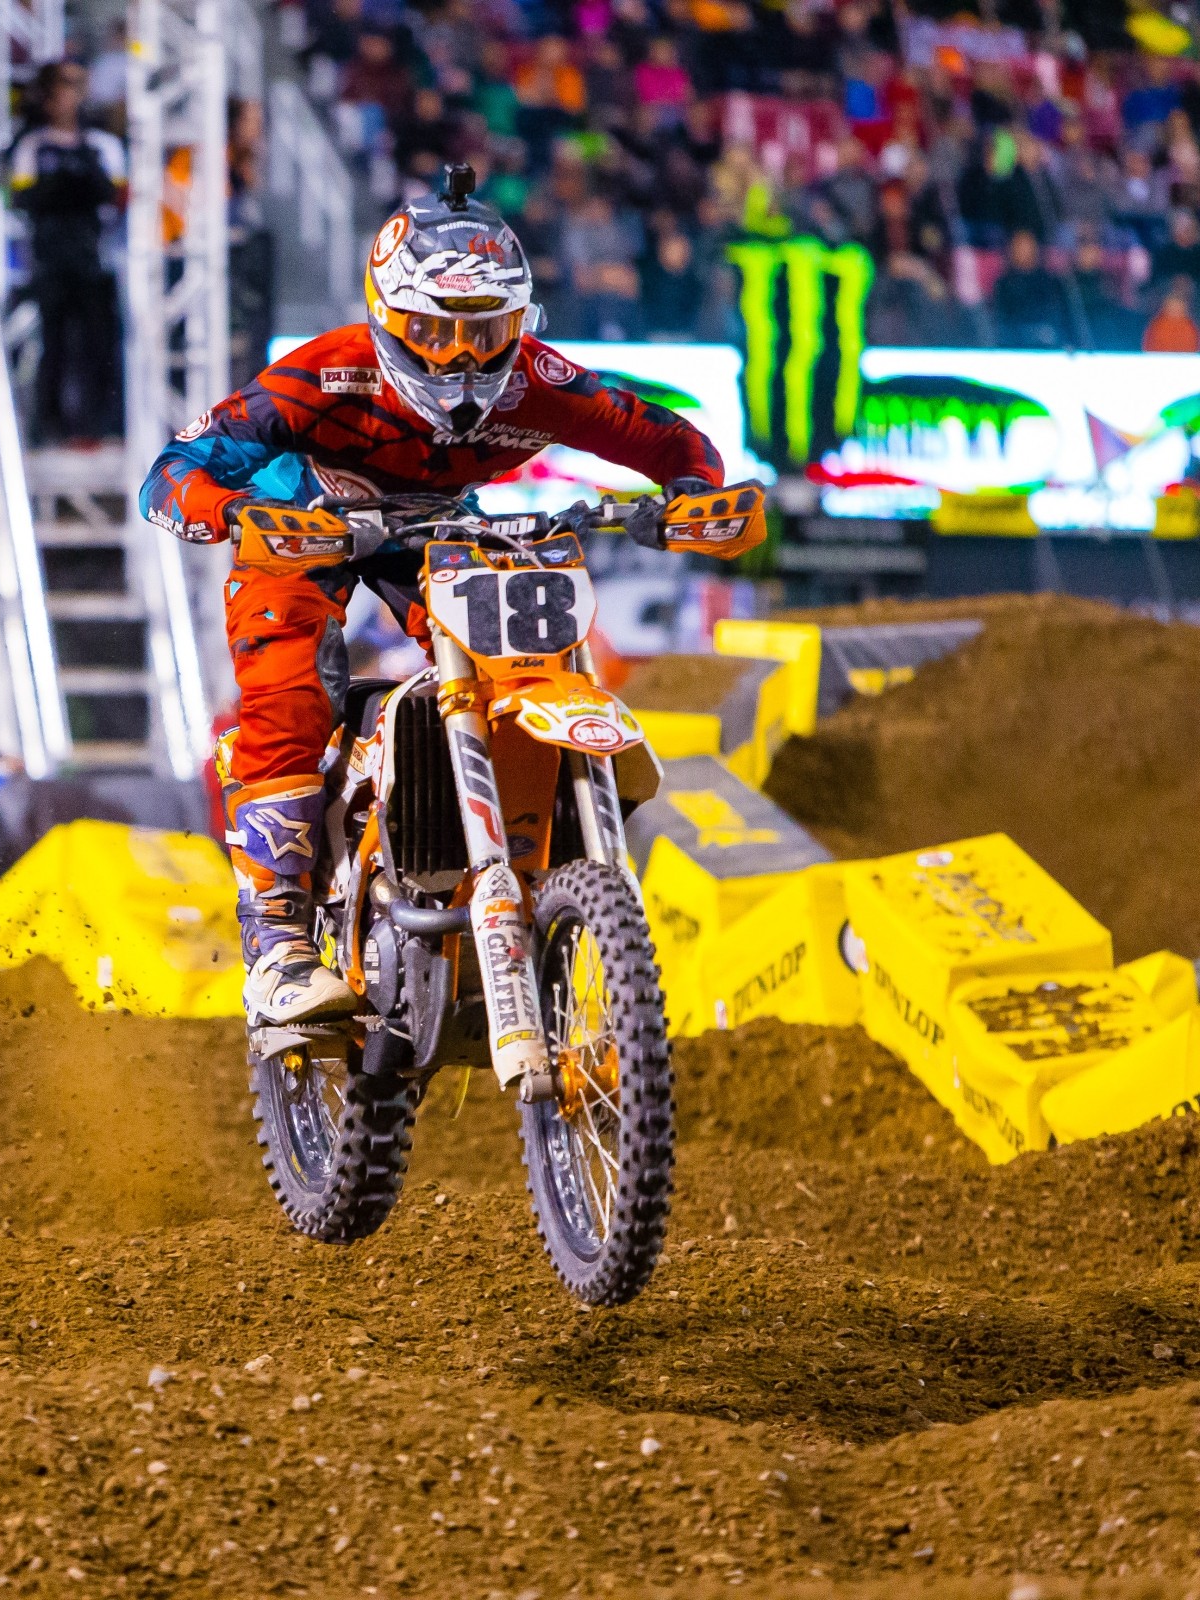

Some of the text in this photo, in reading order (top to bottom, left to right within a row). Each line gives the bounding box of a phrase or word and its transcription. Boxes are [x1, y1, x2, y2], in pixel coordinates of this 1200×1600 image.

[436, 220, 490, 233] SHIMANO
[453, 571, 578, 656] 18
[511, 657, 545, 669] KTM
[487, 932, 521, 1031] GALFER
[732, 941, 807, 1023] DUNLOP
[873, 962, 946, 1049] DUNLOP
